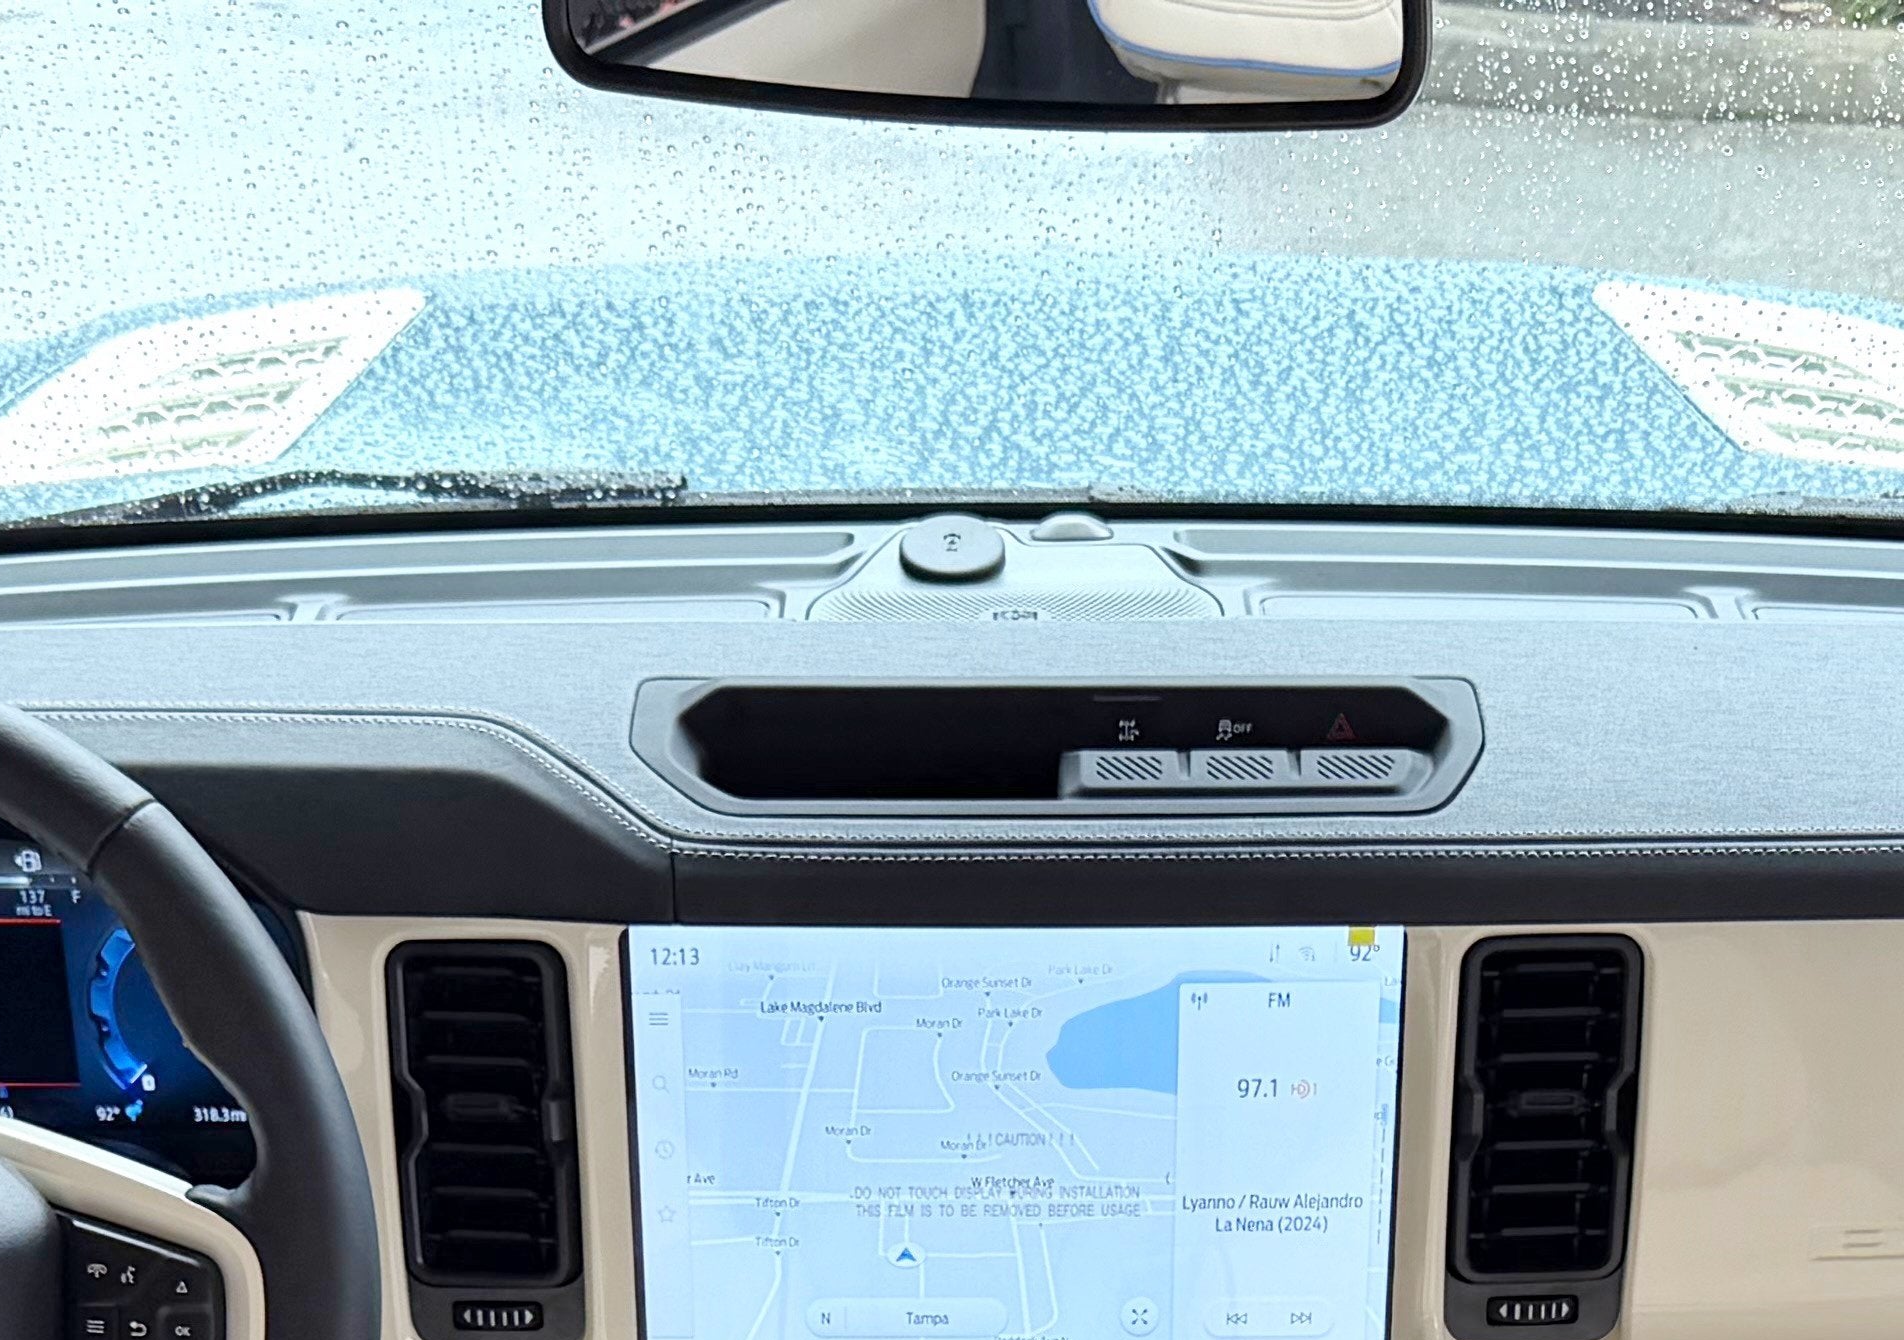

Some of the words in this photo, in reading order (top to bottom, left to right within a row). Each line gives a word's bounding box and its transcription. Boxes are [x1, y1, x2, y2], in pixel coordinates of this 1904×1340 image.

[1233, 723, 1252, 734] OFF
[19, 889, 45, 904] 137
[70, 889, 81, 904] F
[650, 947, 701, 966] 12:13
[1048, 964, 1071, 975] Park
[1074, 964, 1099, 975] Lake
[1102, 964, 1113, 975] Dr
[941, 977, 980, 990] Orange
[982, 977, 1019, 988] Sunset
[1021, 977, 1033, 988] Dr
[1268, 992, 1291, 1008] FM
[760, 1002, 788, 1013] Lake
[790, 1002, 853, 1016] Magdalene
[856, 1002, 882, 1013] Blvd
[978, 1008, 1000, 1018] Park
[1004, 1008, 1029, 1018] Lake
[1031, 1008, 1043, 1018] Dr
[916, 1018, 950, 1029] Moran
[952, 1018, 963, 1029] Dr
[688, 1068, 722, 1079] Moran
[724, 1068, 739, 1079] Rd
[951, 1071, 989, 1083] Orange
[992, 1071, 1027, 1082] Sunset
[1030, 1071, 1042, 1082] Dr
[141, 1074, 156, 1091] 0
[1237, 1079, 1278, 1098] 97.1
[825, 1126, 858, 1136] Moran
[860, 1126, 872, 1136] Dr
[941, 1140, 975, 1150] Moran
[995, 1133, 1047, 1147] CAUTION
[971, 1177, 983, 1188] W
[985, 1176, 1031, 1189] Fletcher
[1033, 1176, 1055, 1188] Ave
[878, 1186, 902, 1199] NOT
[908, 1186, 948, 1199] TOUCH
[955, 1186, 1002, 1199] DISPLAY
[1009, 1187, 1053, 1199] URING
[1059, 1186, 1140, 1199] INSTALLATION
[789, 1198, 801, 1208] Dr
[1182, 1195, 1236, 1213] Lyanno
[1237, 1194, 1246, 1209] /
[1249, 1194, 1290, 1209] Rauw
[1293, 1193, 1364, 1211] Alejandro
[856, 1204, 882, 1217] THIS
[888, 1204, 914, 1217] FILM
[921, 1204, 932, 1217] IS
[940, 1204, 955, 1217] TO
[961, 1204, 978, 1217] BE
[984, 1204, 1042, 1217] REMOVED
[1048, 1204, 1096, 1217] BEFORE
[1101, 1204, 1141, 1217] USAGE
[1215, 1217, 1232, 1232] La
[1236, 1217, 1274, 1232] Nena
[1278, 1216, 1328, 1233] (2024)
[789, 1237, 800, 1247] Dr
[821, 1313, 831, 1324] N
[906, 1312, 949, 1327] Tampa
[175, 1326, 191, 1336] OK
